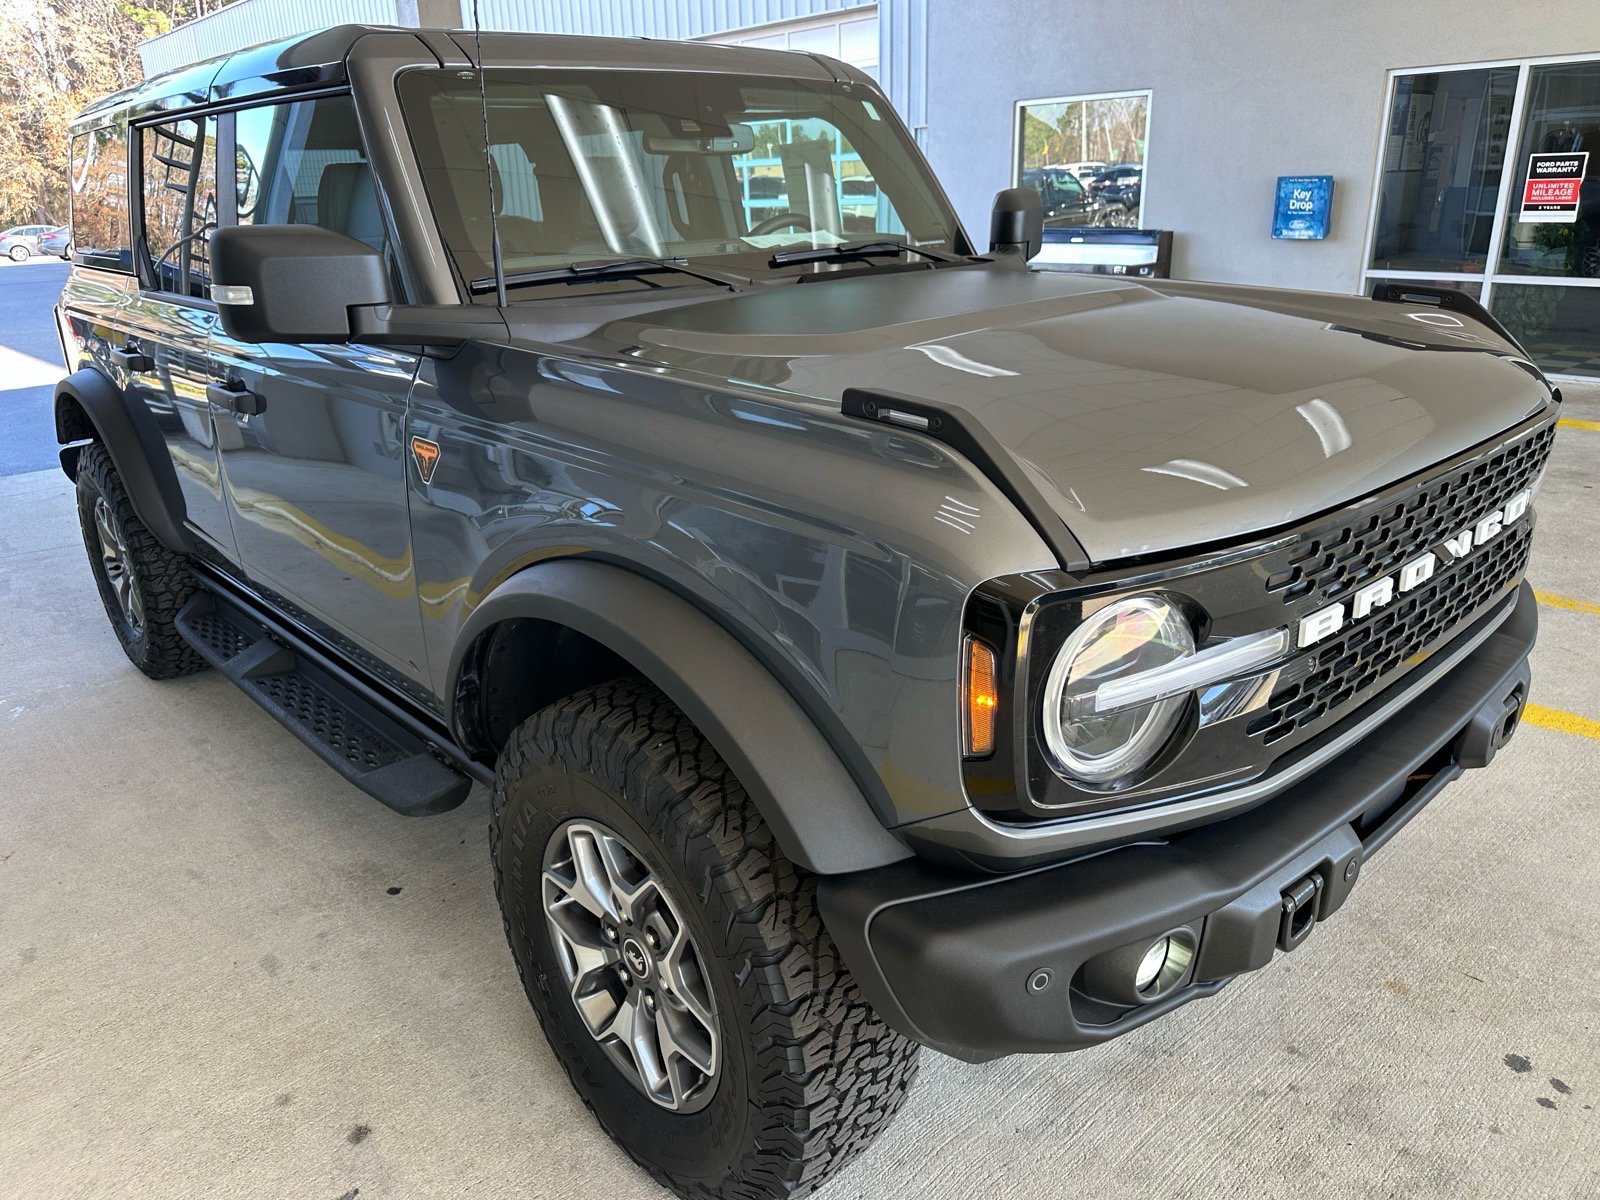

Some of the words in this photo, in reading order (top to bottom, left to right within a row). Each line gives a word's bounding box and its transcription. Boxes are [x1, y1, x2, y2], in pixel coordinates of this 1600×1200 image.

[1293, 188, 1312, 201] Key
[1289, 199, 1313, 211] Drop
[1298, 488, 1531, 648] BRONCO
